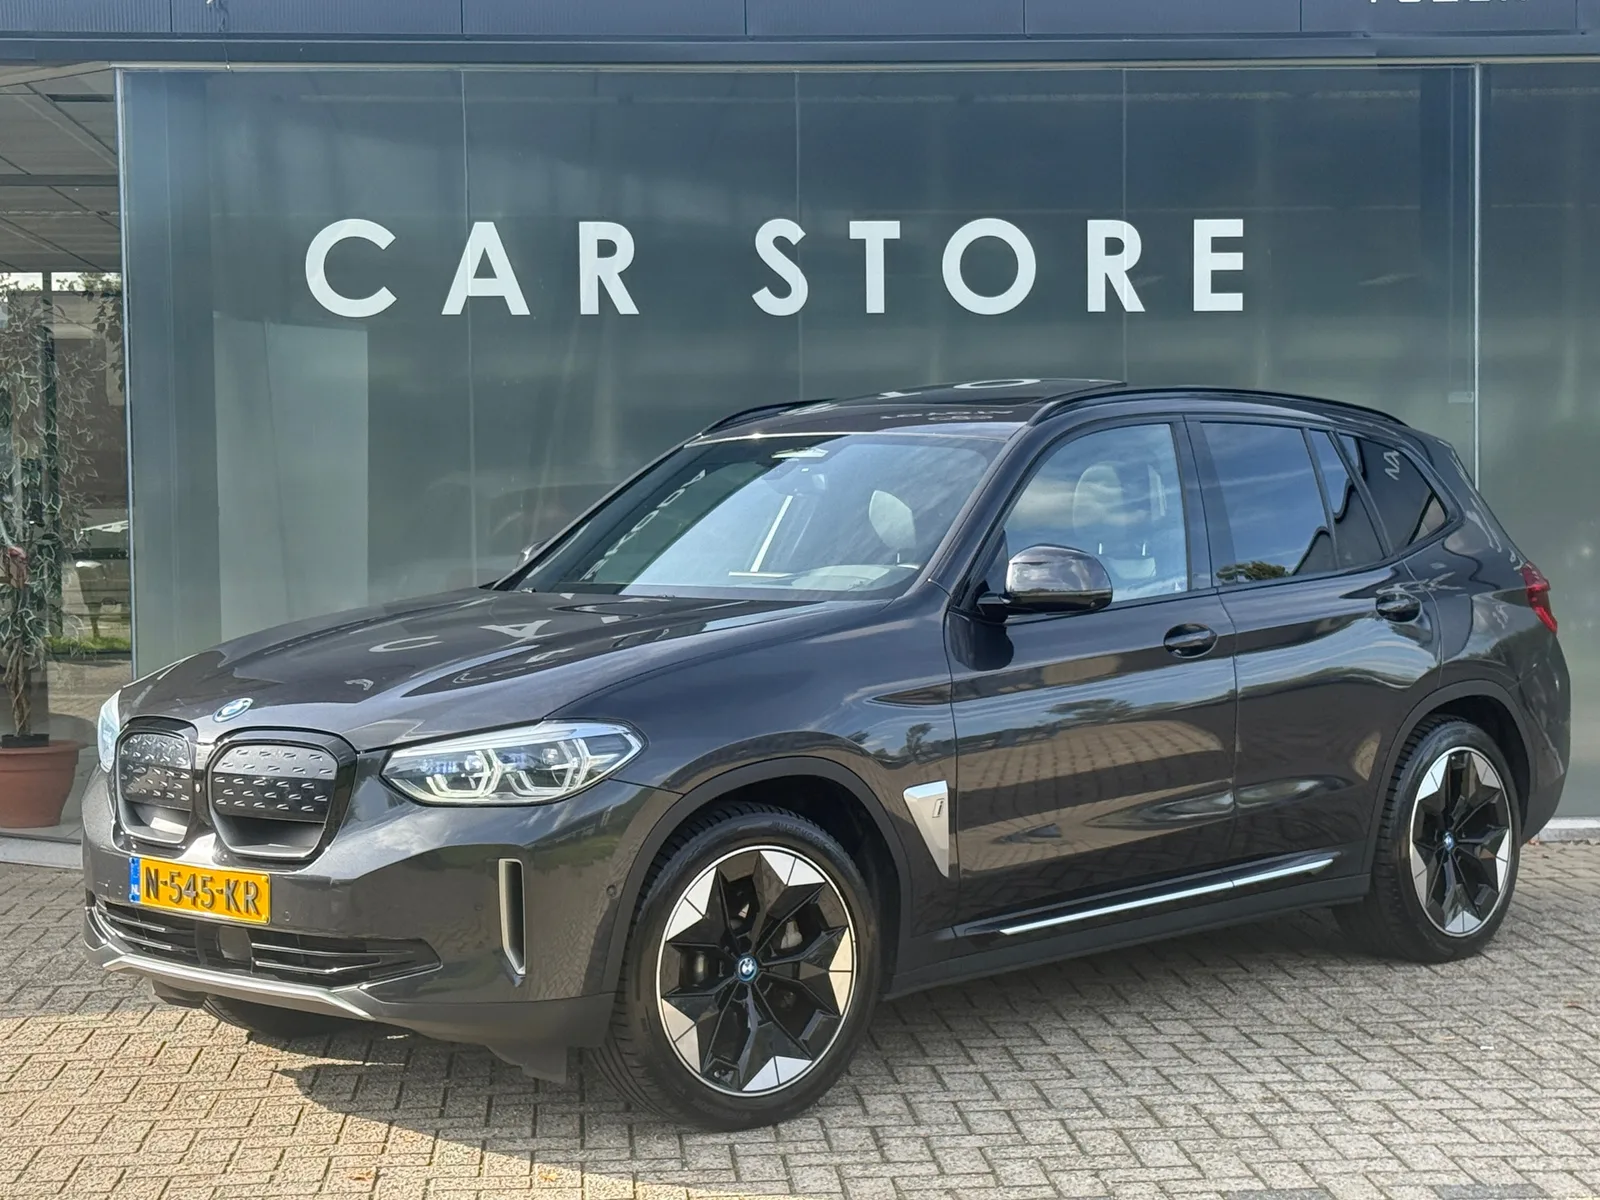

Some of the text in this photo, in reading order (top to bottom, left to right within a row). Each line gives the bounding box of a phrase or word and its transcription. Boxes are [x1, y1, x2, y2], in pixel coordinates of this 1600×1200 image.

[305, 217, 1244, 317] CAR STORE
[145, 866, 260, 916] N-545-KR
